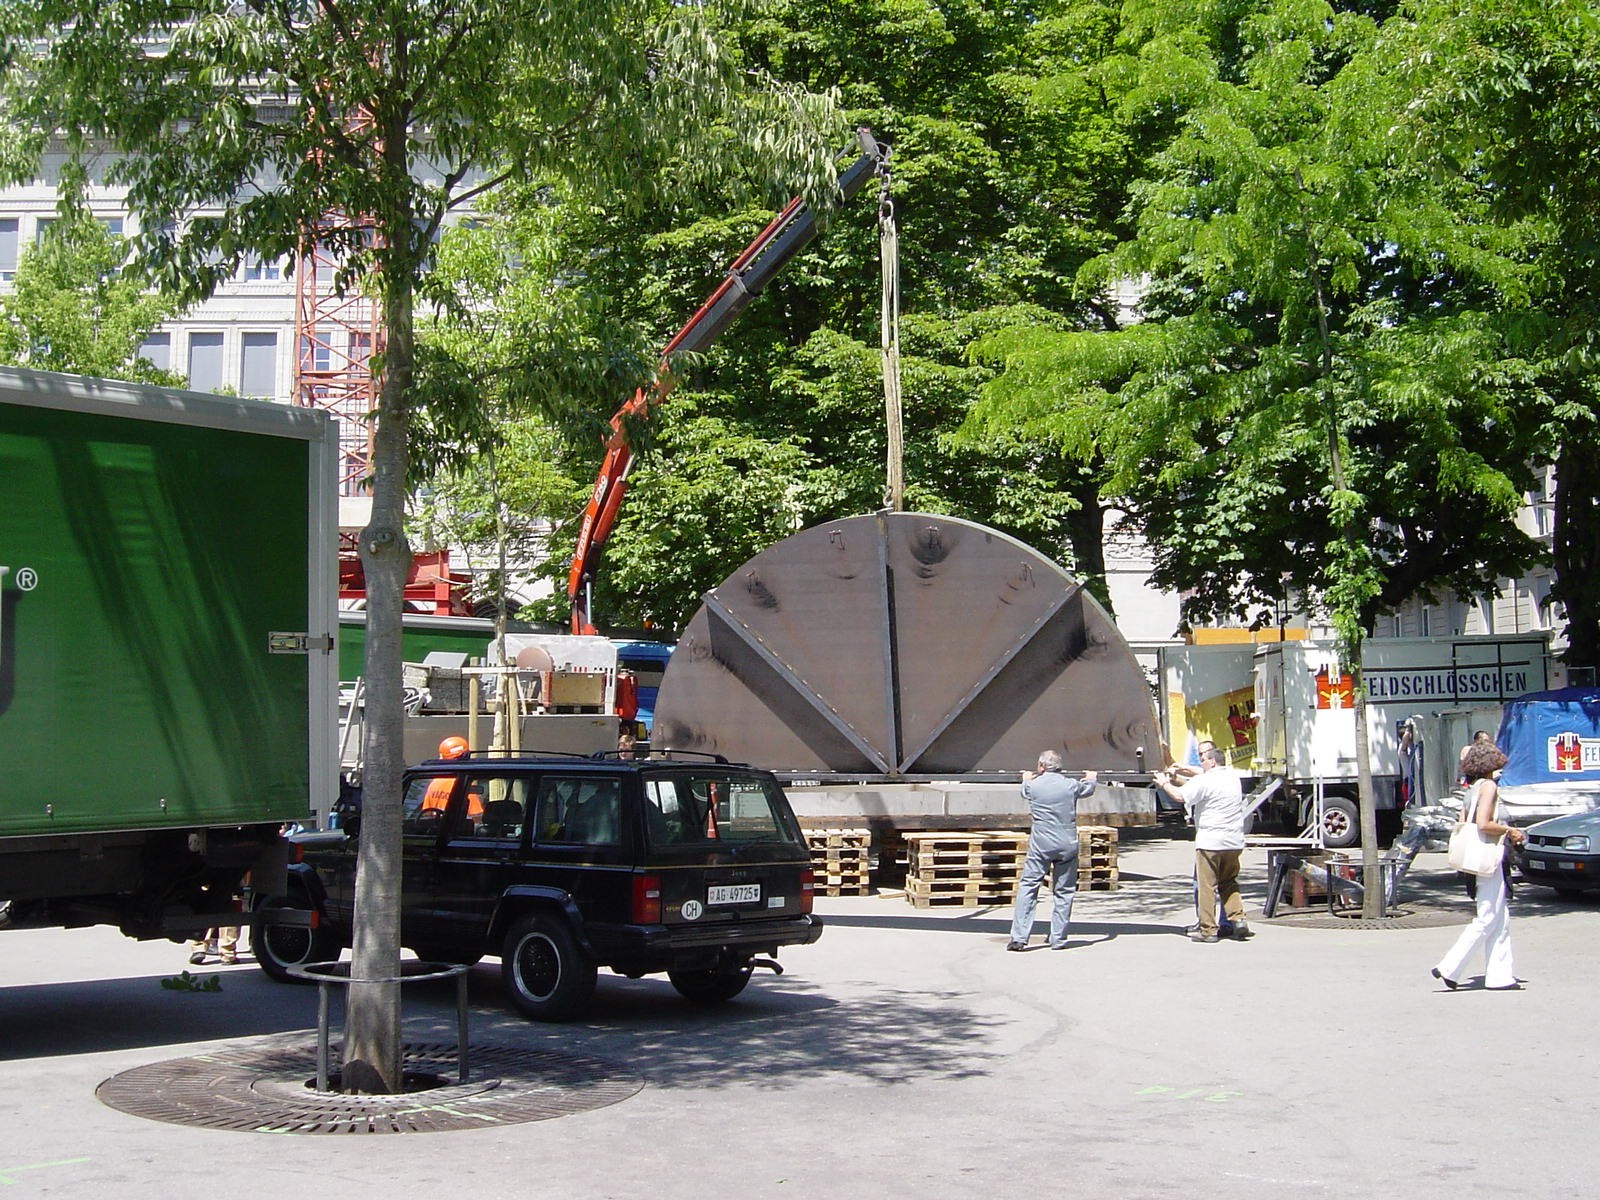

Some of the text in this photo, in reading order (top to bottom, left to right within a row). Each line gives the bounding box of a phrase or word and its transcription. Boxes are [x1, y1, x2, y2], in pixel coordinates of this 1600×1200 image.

[1363, 671, 1527, 697] ELDSCHLÖSSCHEN
[716, 887, 753, 901] AG 49725
[686, 903, 697, 917] CH
